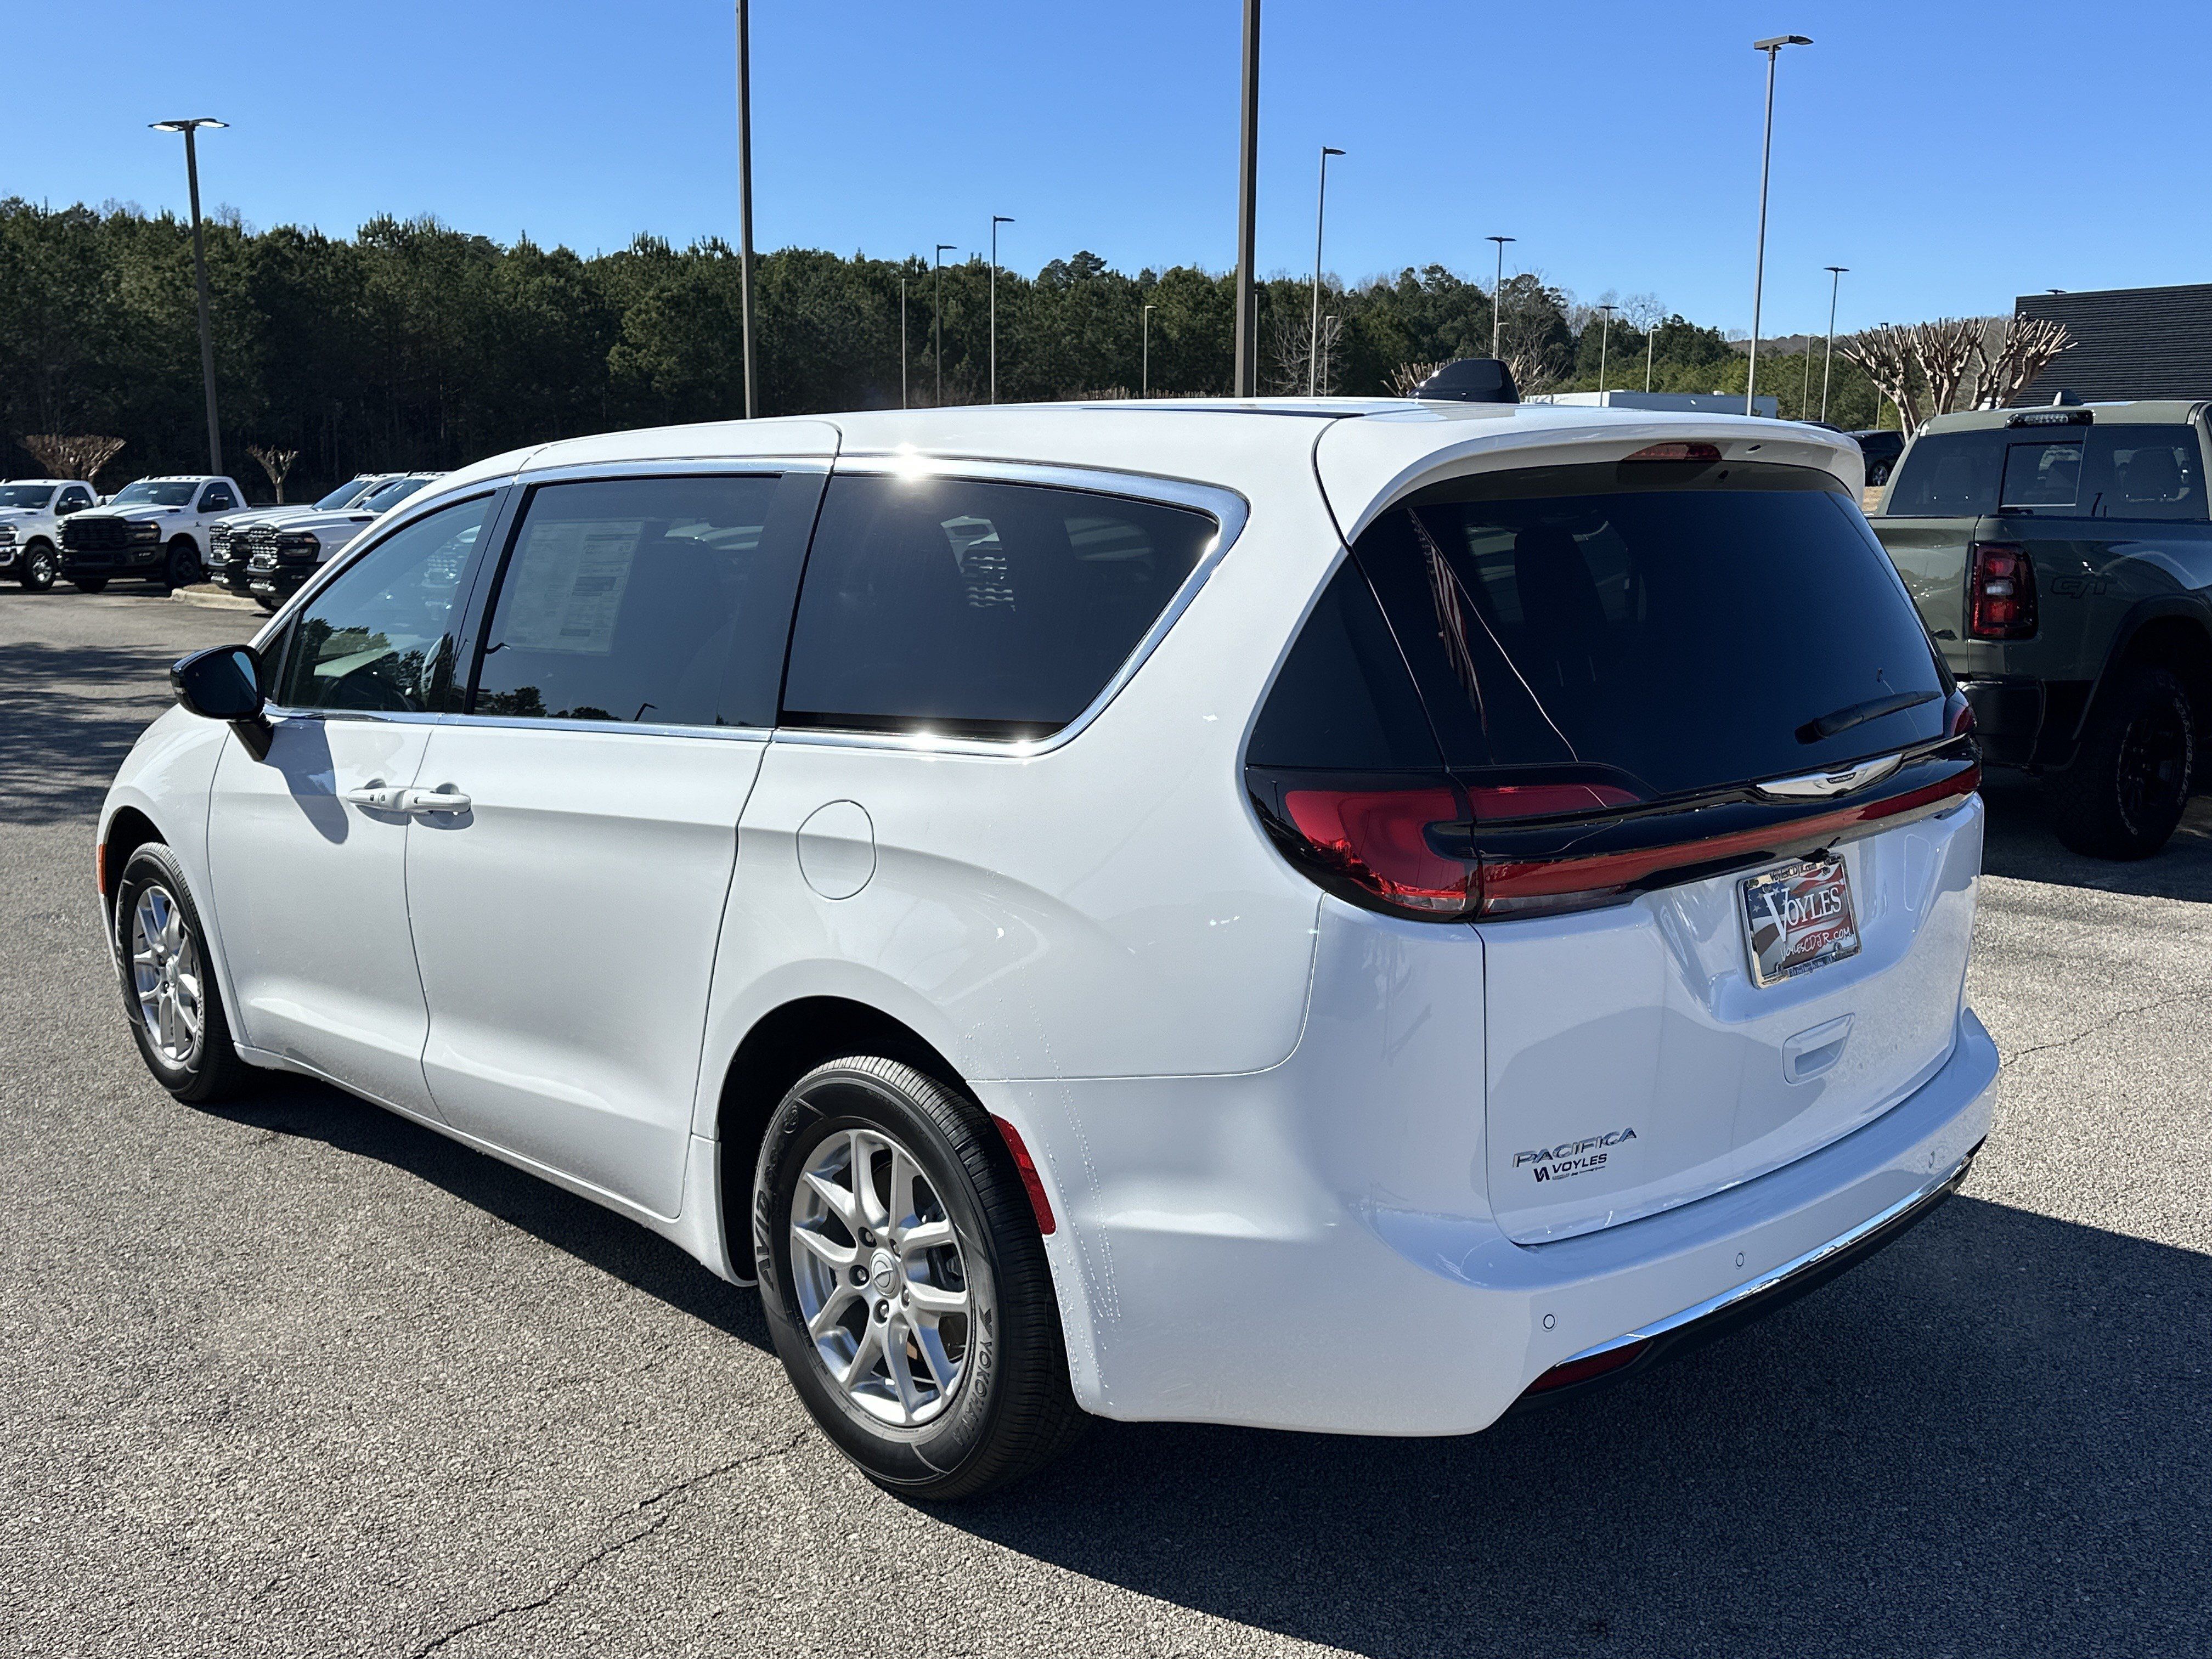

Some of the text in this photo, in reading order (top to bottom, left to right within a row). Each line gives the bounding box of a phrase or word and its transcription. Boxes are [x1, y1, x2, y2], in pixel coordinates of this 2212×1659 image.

[1763, 887, 1842, 942] VOYLES
[1513, 1127, 1637, 1168] PACIFICA
[1552, 1153, 1607, 1173] VOYLES
[952, 1341, 992, 1447] YOKOHAMA
